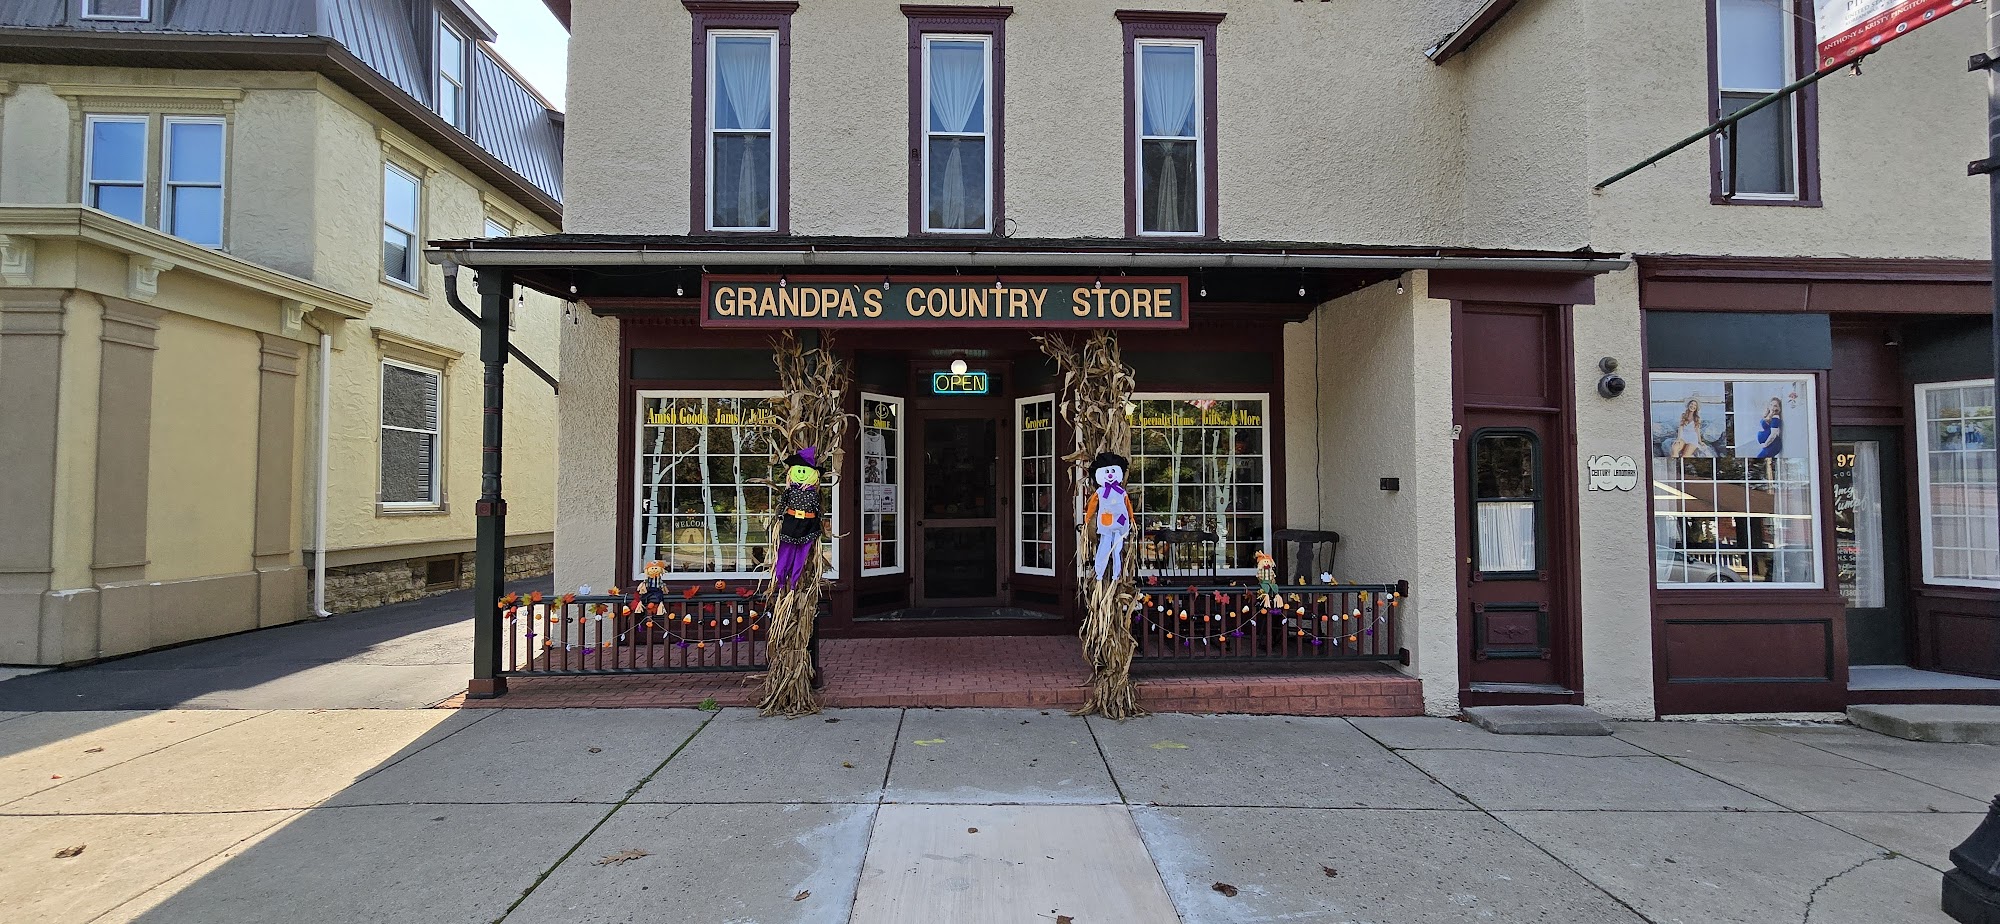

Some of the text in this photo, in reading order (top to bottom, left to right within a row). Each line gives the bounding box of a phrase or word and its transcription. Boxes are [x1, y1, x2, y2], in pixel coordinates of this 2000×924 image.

[1823, 31, 1857, 52] ANTHONY
[1864, 15, 1889, 32] KRISTY
[905, 287, 1049, 319] COUNTRY
[1071, 287, 1173, 319] STORE
[936, 375, 985, 391] OPEN
[647, 408, 676, 424] Amish
[679, 408, 708, 425] Goods
[715, 408, 739, 424] Jams
[873, 419, 891, 429] SMILE
[1138, 412, 1172, 429] Specialty
[1173, 412, 1195, 426] Items
[1239, 410, 1261, 426] More
[1836, 453, 1856, 468] 97
[1587, 454, 1639, 491] 100
